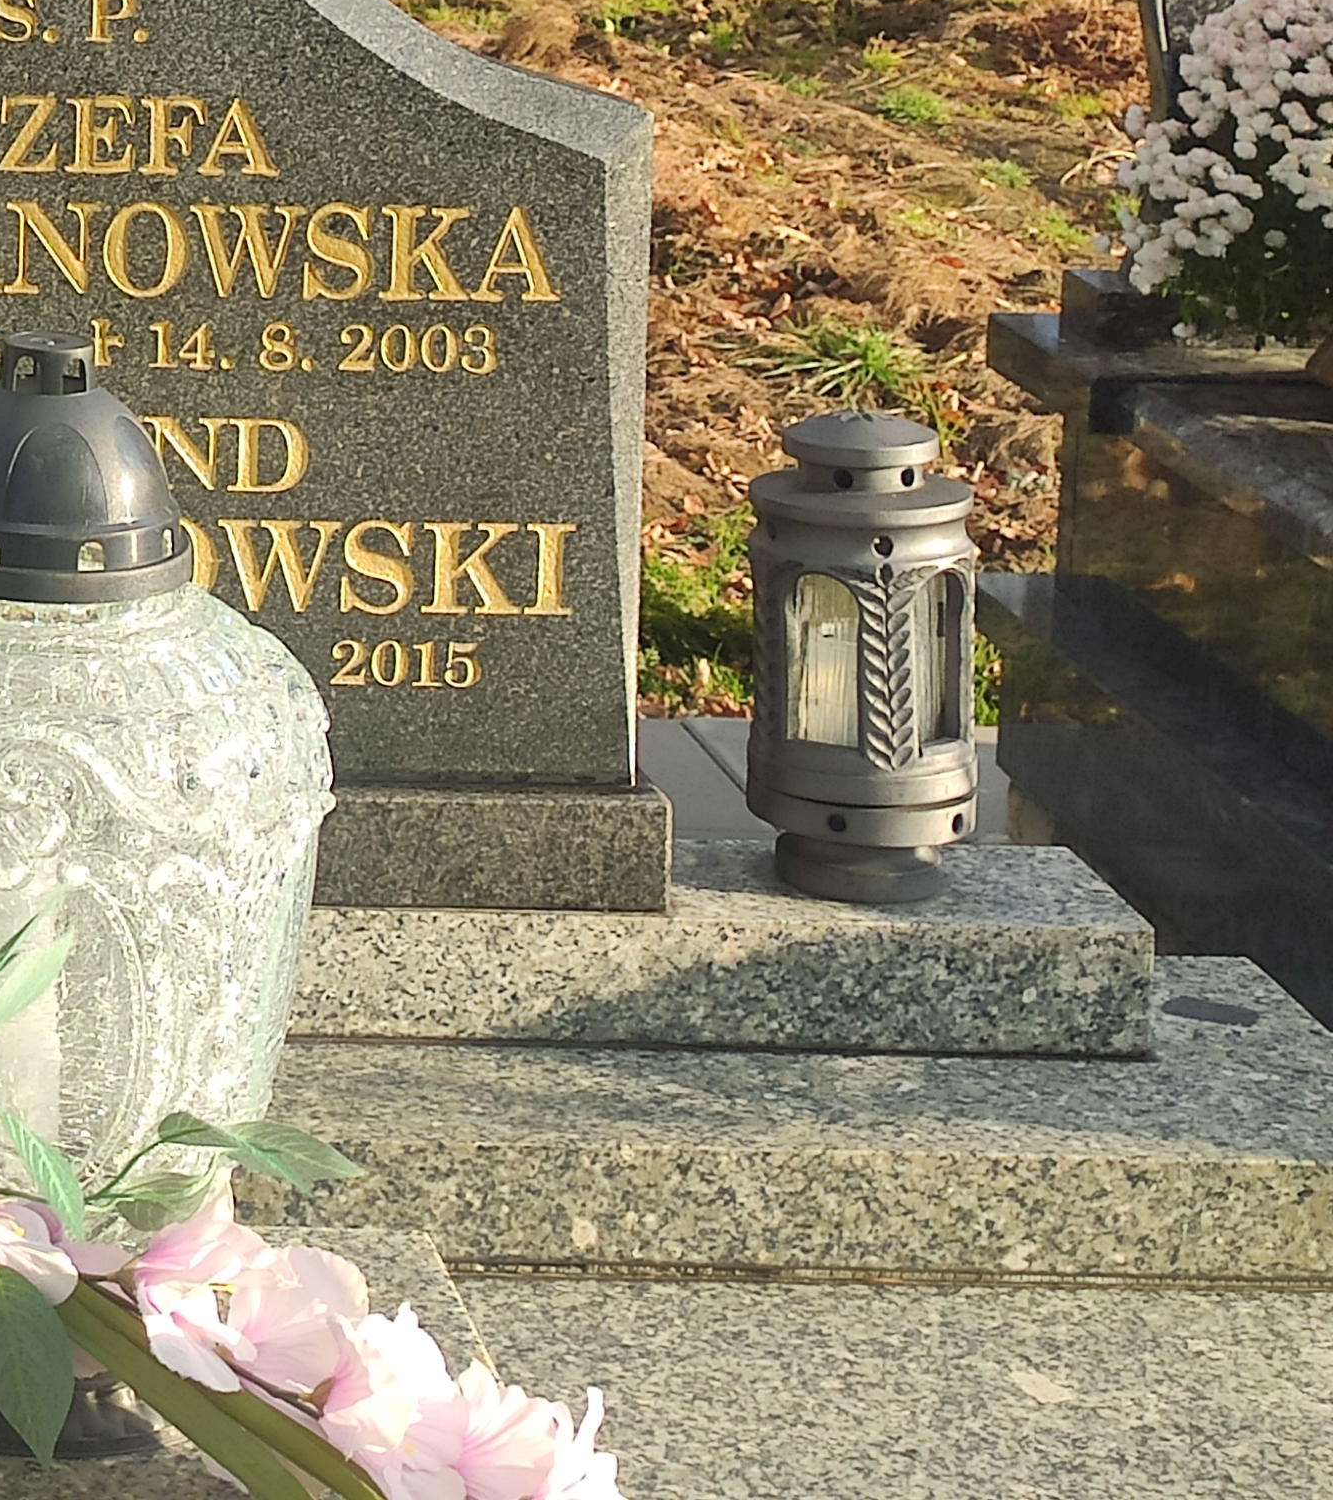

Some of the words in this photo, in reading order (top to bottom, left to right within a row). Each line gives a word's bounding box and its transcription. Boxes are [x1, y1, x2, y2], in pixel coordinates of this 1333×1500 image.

[149, 320, 233, 371] 14.
[258, 322, 314, 372] 8.
[338, 324, 498, 375] 2003
[330, 639, 482, 688] 2015
